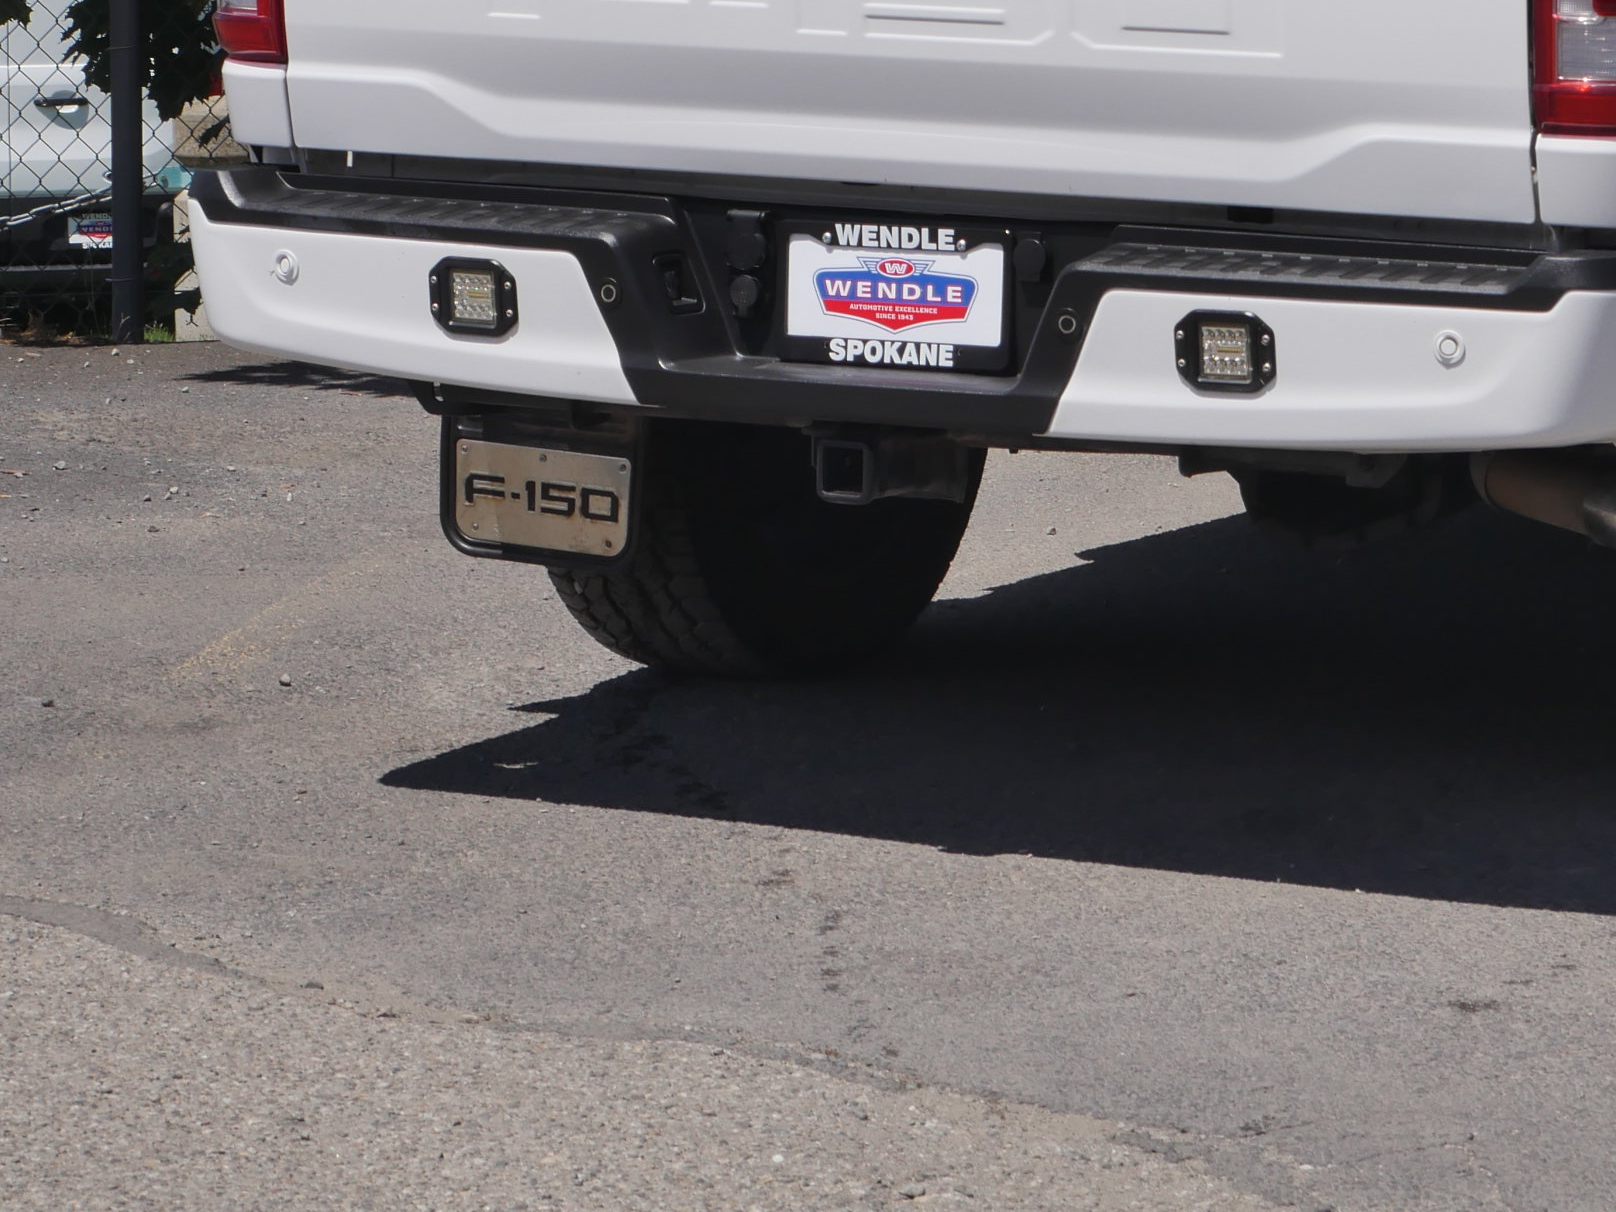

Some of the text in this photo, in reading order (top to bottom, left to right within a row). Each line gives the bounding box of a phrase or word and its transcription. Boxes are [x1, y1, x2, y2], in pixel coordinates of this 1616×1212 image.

[834, 223, 956, 251] WENDLE
[825, 279, 962, 303] WENDLE
[849, 303, 938, 314] AUTOMOTIVE EXCELLENCE
[875, 312, 914, 321] SINCE 1943
[828, 338, 954, 367] SPOKANE
[464, 472, 619, 523] F-150
